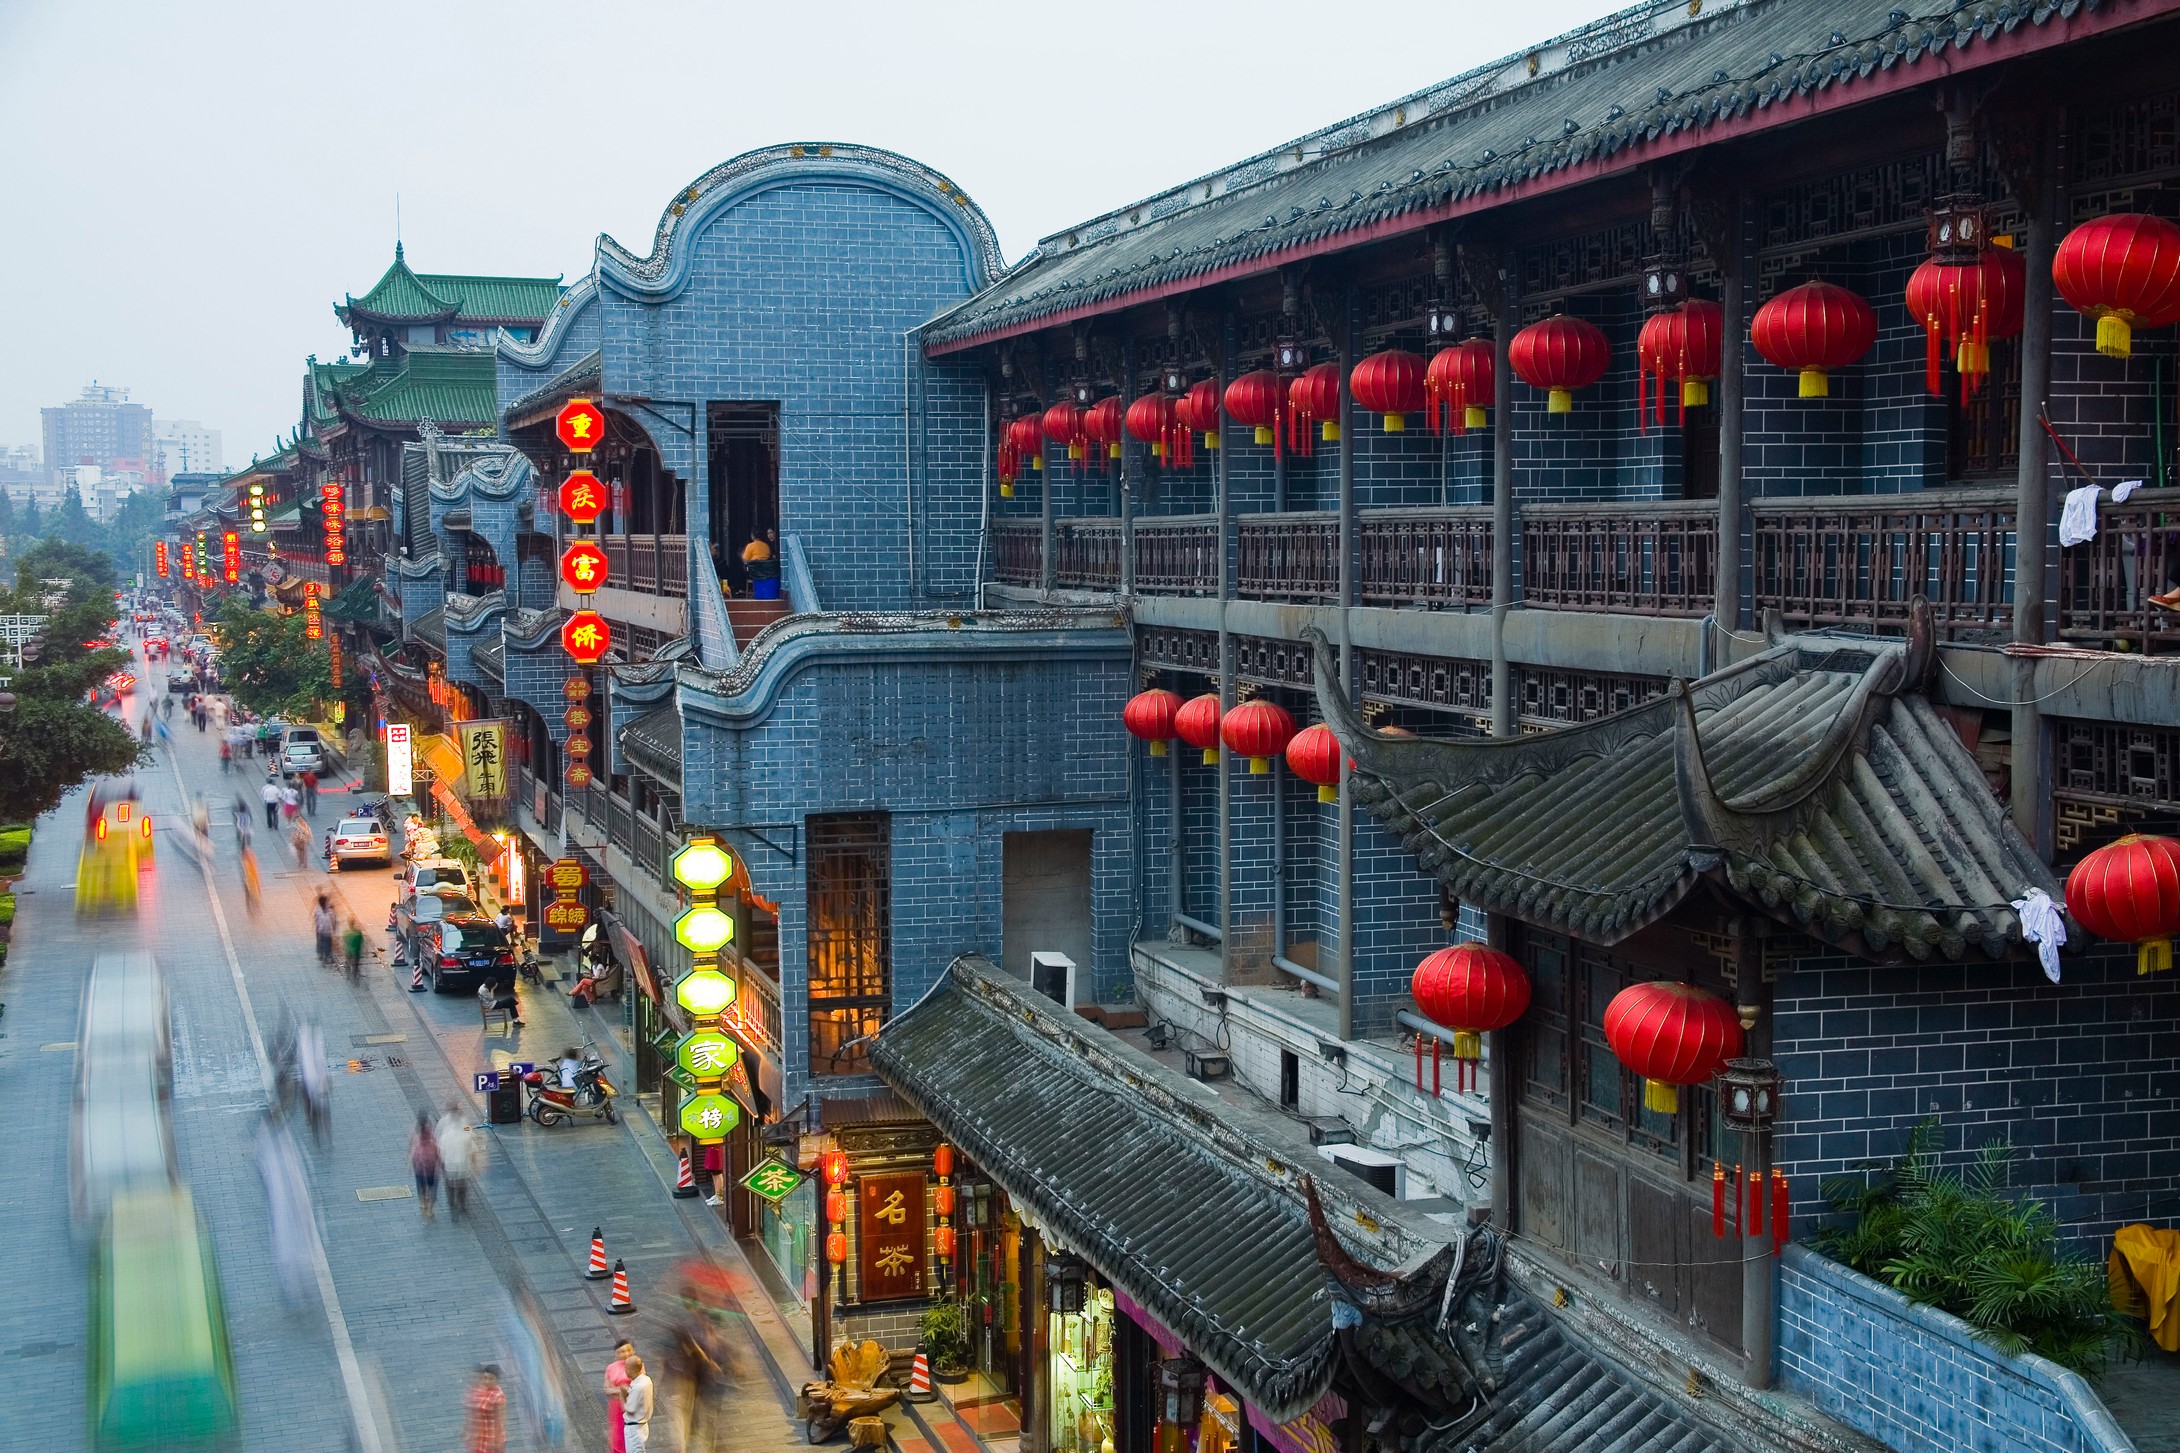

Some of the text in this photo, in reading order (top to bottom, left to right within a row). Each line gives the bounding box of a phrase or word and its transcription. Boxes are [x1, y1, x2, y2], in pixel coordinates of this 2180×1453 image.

[566, 413, 603, 651] 重庆富侨
[569, 710, 589, 783] 蓉宝斋
[478, 1075, 488, 1091] P
[757, 1168, 794, 1192] 茶
[874, 1189, 915, 1277] 名茶
